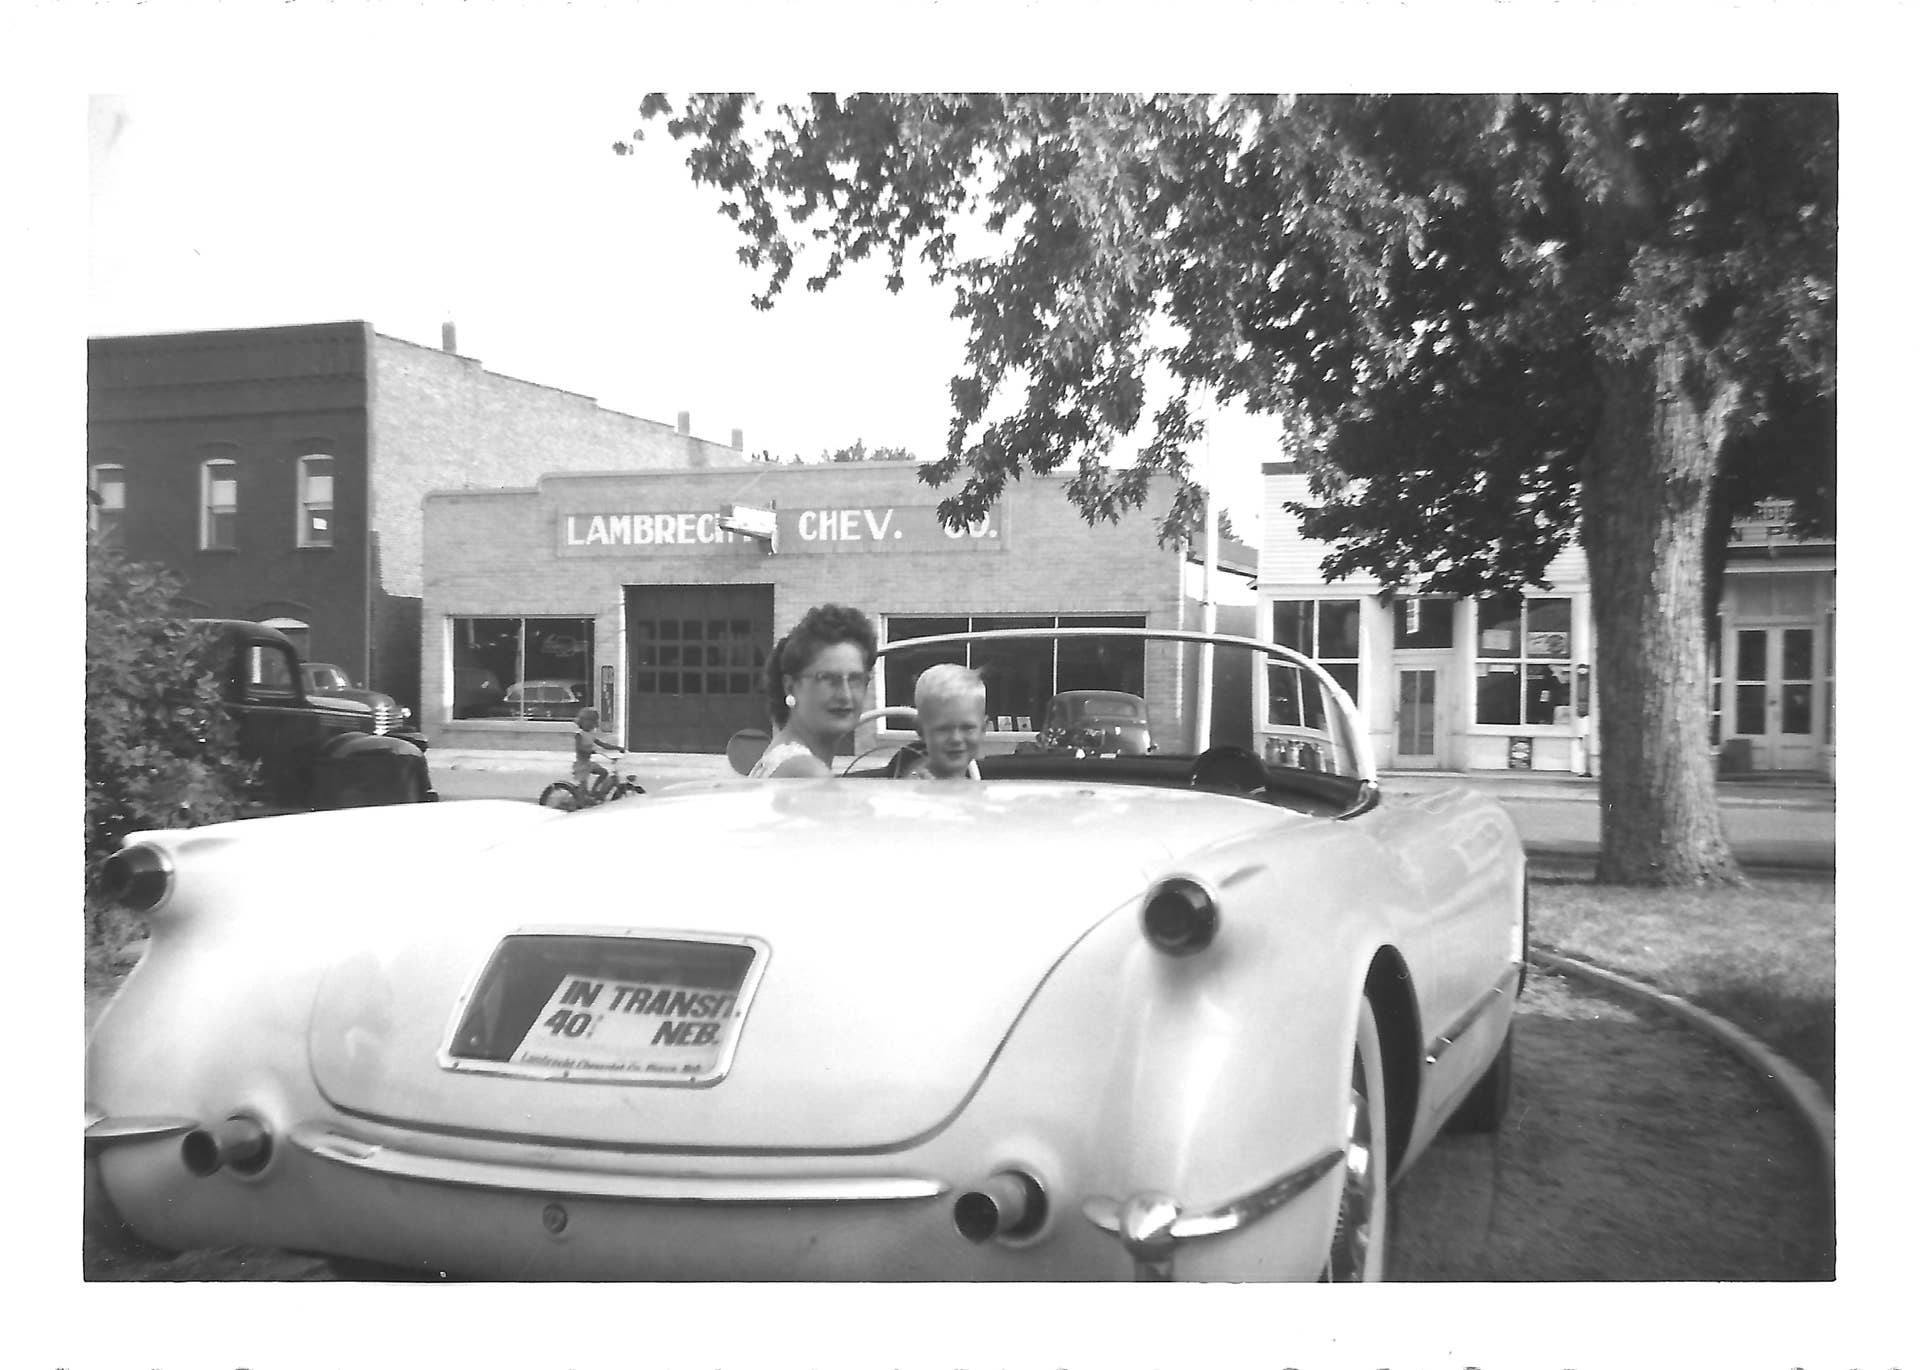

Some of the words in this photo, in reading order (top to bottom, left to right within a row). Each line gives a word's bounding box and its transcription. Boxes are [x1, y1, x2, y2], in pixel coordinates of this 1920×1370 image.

[567, 513, 752, 546] LAMBRECH
[799, 508, 903, 541] CHEV.
[559, 980, 604, 1008] IN
[650, 1020, 721, 1046] NEB.
